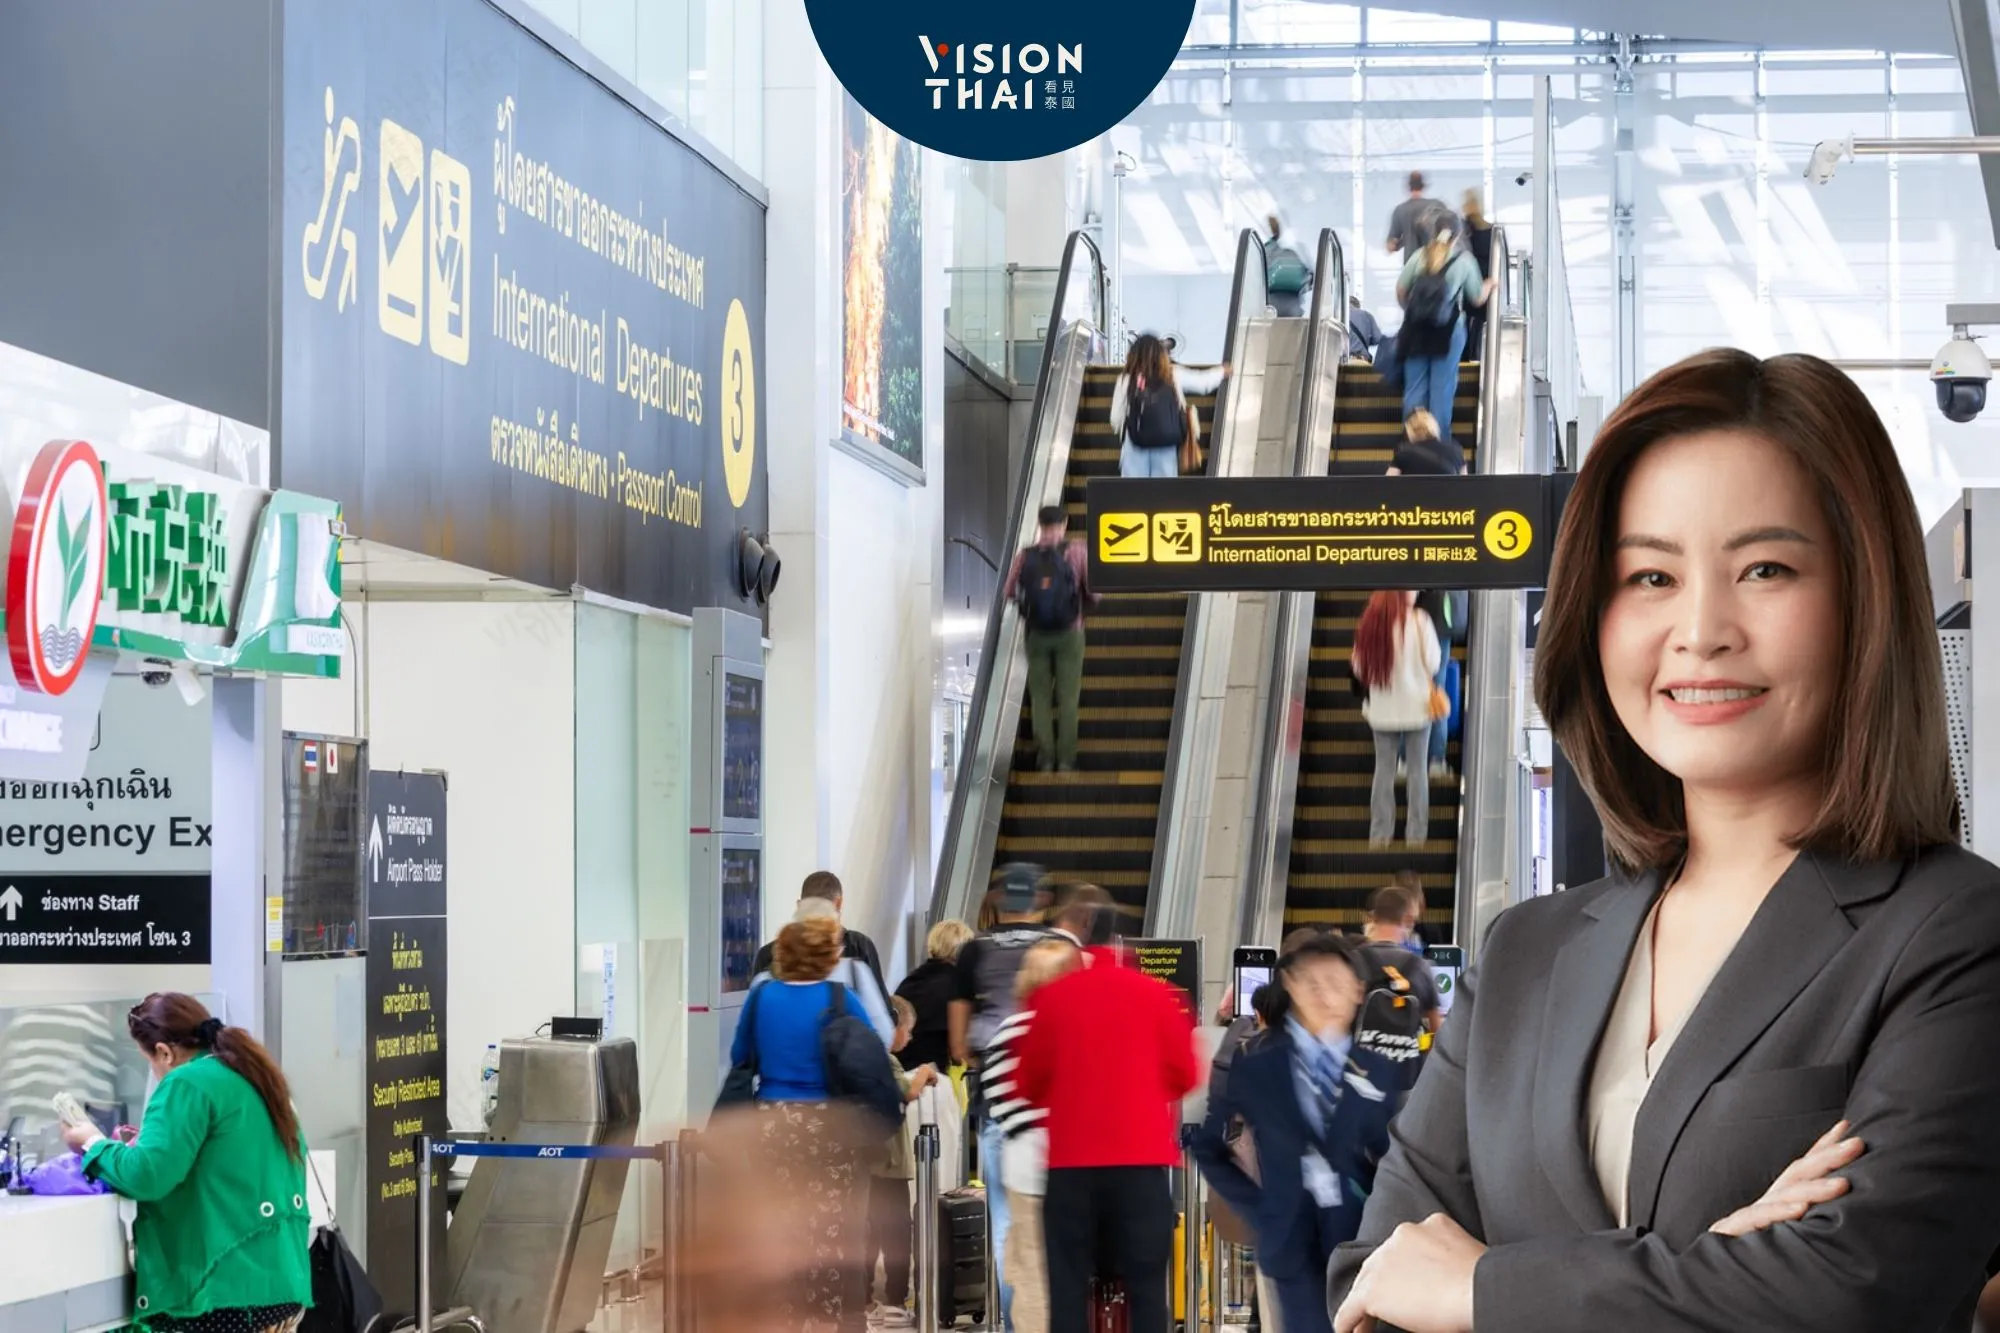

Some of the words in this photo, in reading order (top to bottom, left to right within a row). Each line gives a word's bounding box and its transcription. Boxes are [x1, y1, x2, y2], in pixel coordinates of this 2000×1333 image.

[494, 95, 704, 310] ผู้โดยสารขาออกระหว่างประเทศ
[493, 253, 606, 385] International
[617, 317, 703, 425] Departures
[731, 348, 743, 453] 3
[491, 407, 608, 499] ตรวจหนังสือเดินทาง
[617, 451, 665, 525] Passport
[666, 469, 703, 529] Control
[1208, 503, 1475, 534] ผู้โดยสารขาออกระหว่างประเทศ
[1497, 518, 1518, 551] 3
[1209, 545, 1311, 562] International
[1316, 545, 1408, 564] Departures
[1423, 547, 1478, 562] 国际出发
[0, 824, 155, 855] ergency
[387, 857, 408, 887] Airport
[408, 858, 423, 881] Pass
[424, 857, 443, 881] Holder
[41, 889, 94, 911] ช่องทาง
[99, 894, 140, 911] Staff
[181, 930, 191, 946] 3
[1140, 957, 1177, 965] Departure
[1140, 967, 1177, 976] Passenger
[373, 1080, 398, 1109] Security
[398, 1076, 426, 1102] Restricted
[427, 1075, 440, 1097] Area
[537, 1146, 565, 1157] AOT
